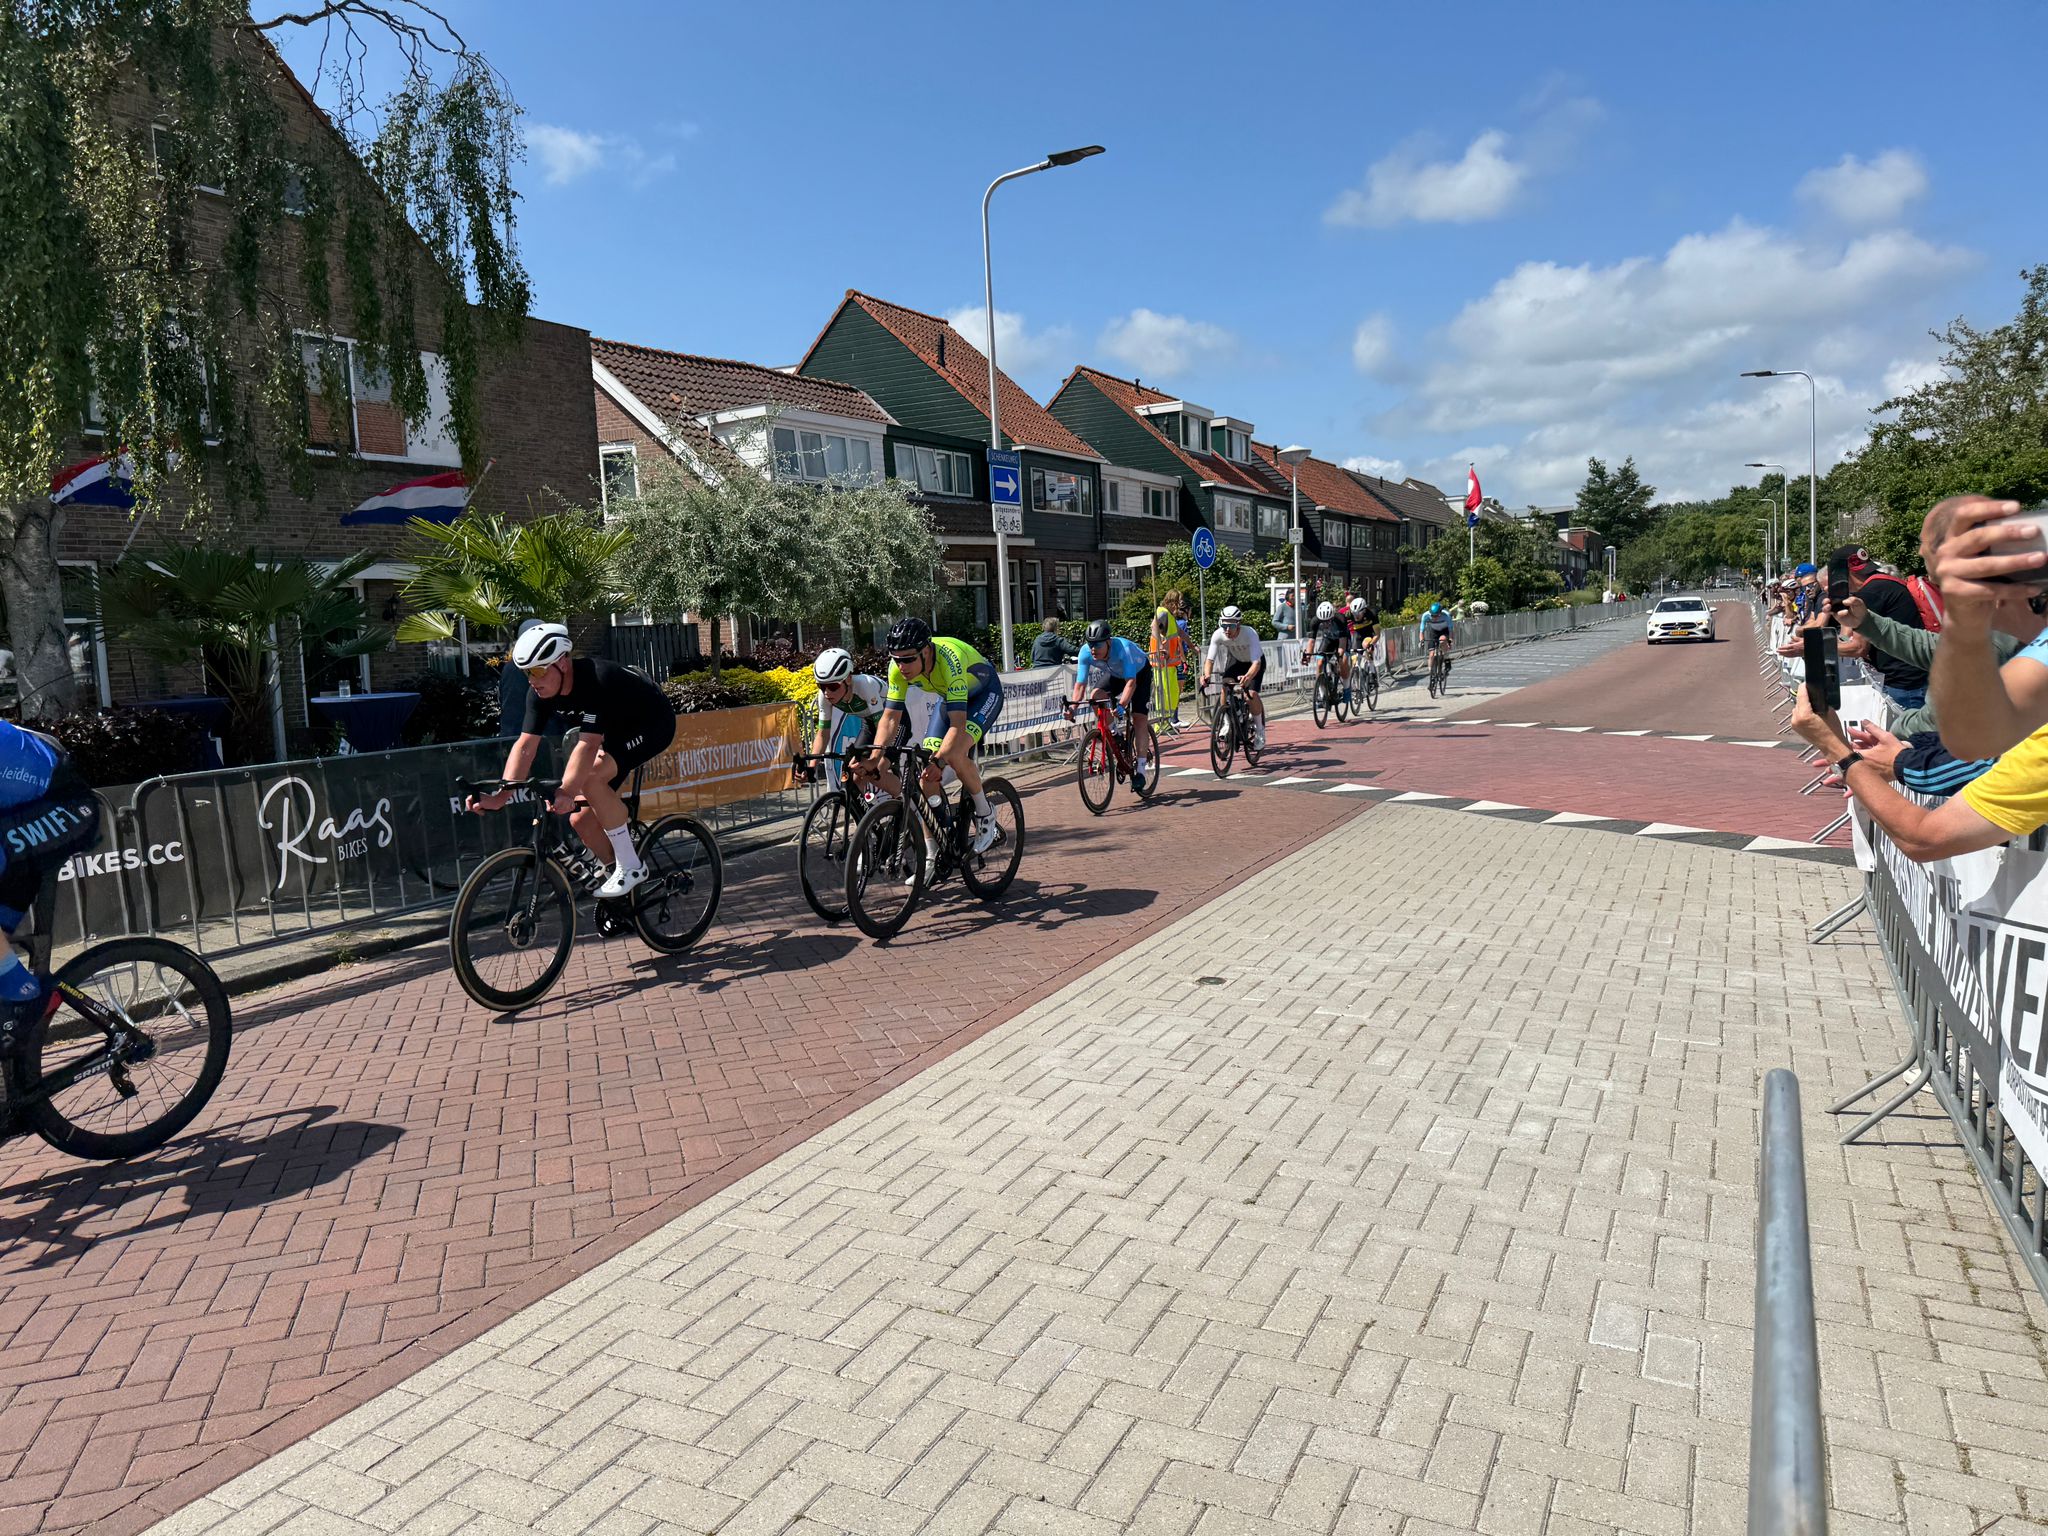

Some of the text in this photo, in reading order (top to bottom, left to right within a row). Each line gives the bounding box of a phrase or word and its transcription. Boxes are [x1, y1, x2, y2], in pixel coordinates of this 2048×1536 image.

[1002, 681, 1043, 699] ERSTEEGEN
[6, 806, 81, 853] SWIFT
[258, 776, 393, 889] Raas
[337, 837, 369, 862] BIKES
[58, 981, 86, 1000] JUMBO
[73, 1059, 115, 1082] SRAM
